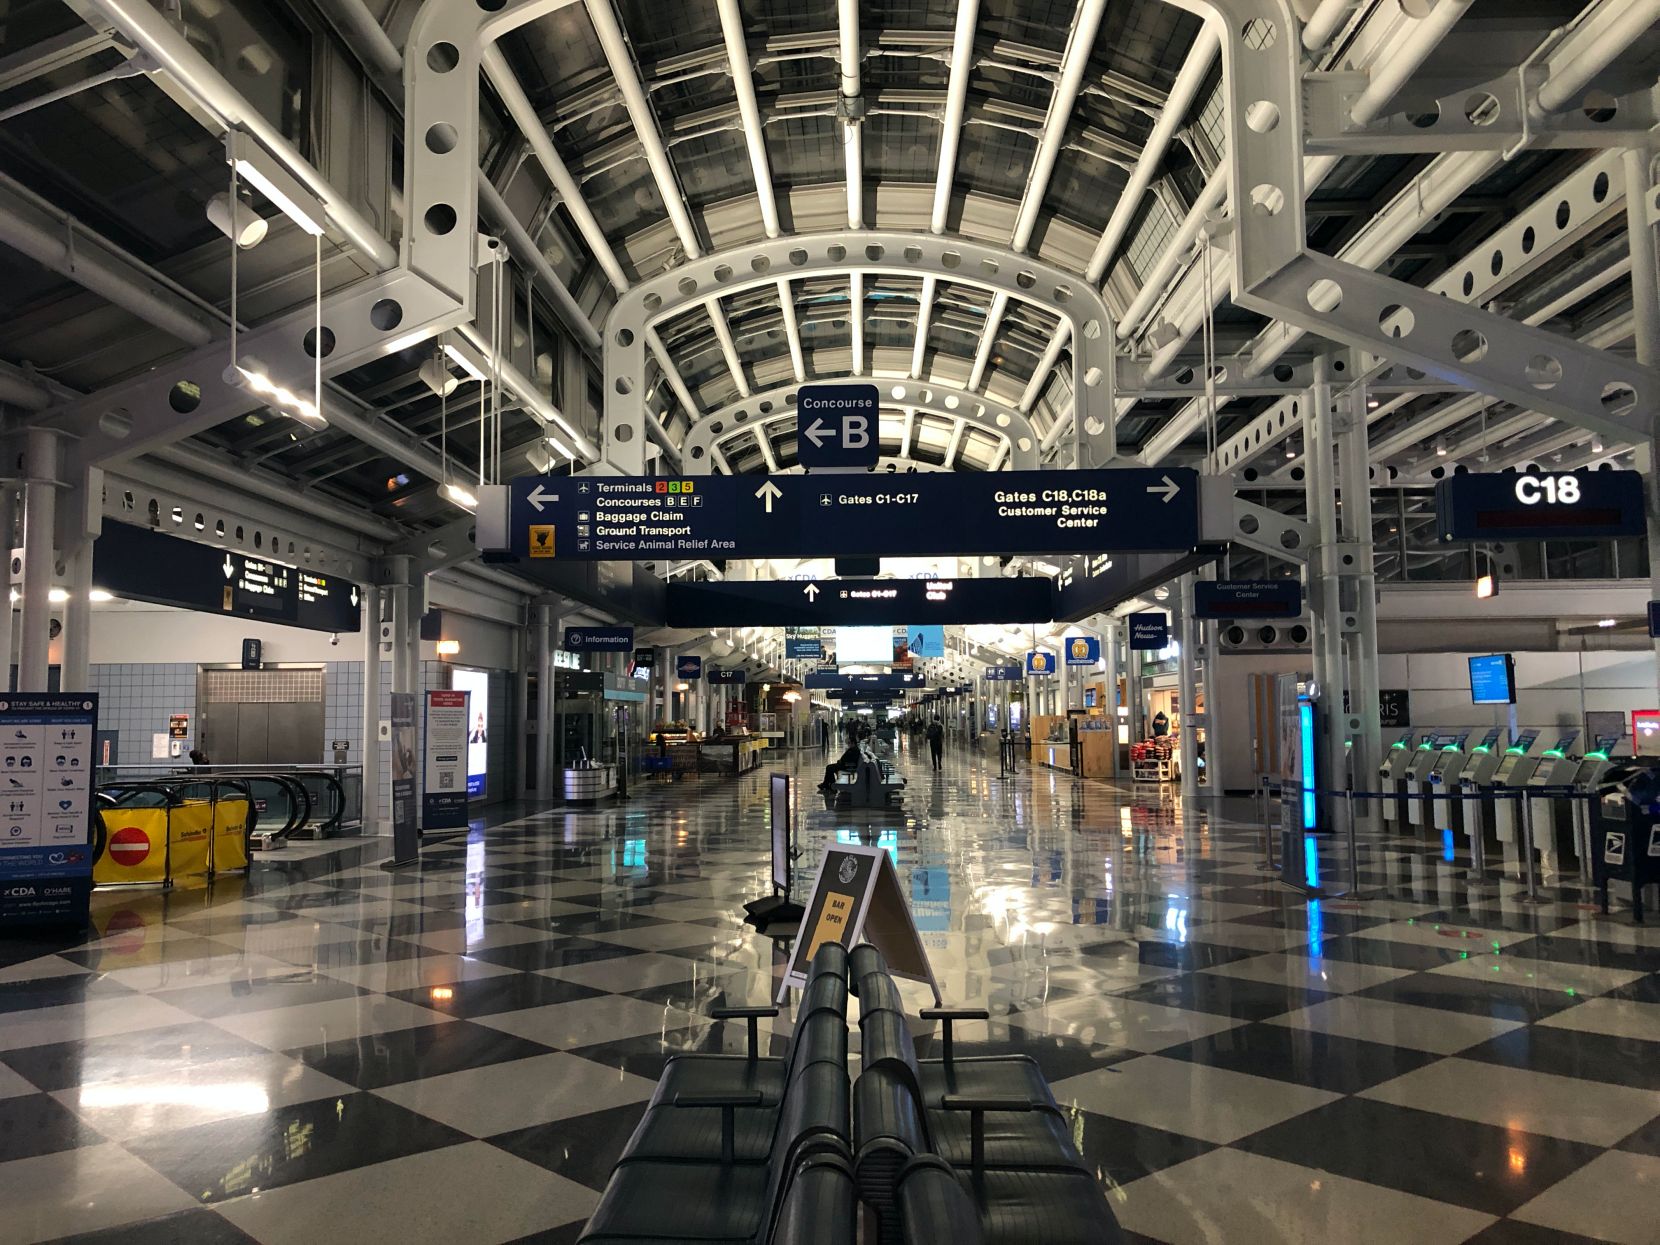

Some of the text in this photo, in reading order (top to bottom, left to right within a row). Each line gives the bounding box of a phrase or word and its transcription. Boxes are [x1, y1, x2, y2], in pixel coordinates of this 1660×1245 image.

[804, 397, 873, 408] Concourse
[843, 416, 869, 449] B
[597, 483, 653, 492] Terminals
[1515, 476, 1581, 504] C18
[597, 497, 700, 507] Concourses B E F
[839, 493, 919, 505] Gates C1-C17
[995, 489, 1107, 504] Gates C18,C18a
[999, 505, 1107, 517] Customer Service
[597, 511, 684, 523] Baggage Claim
[1057, 517, 1099, 528] Center
[596, 525, 691, 537] Ground Transport
[596, 539, 736, 550] Service Animal Relief Area
[1216, 582, 1279, 591] Customer Service
[1235, 591, 1260, 599] Center
[1133, 623, 1164, 631] Hudson
[585, 635, 629, 643] Information
[1134, 631, 1158, 640] News
[11, 887, 36, 896] CDA
[832, 900, 845, 909] BAR
[826, 913, 843, 924] OPEN
